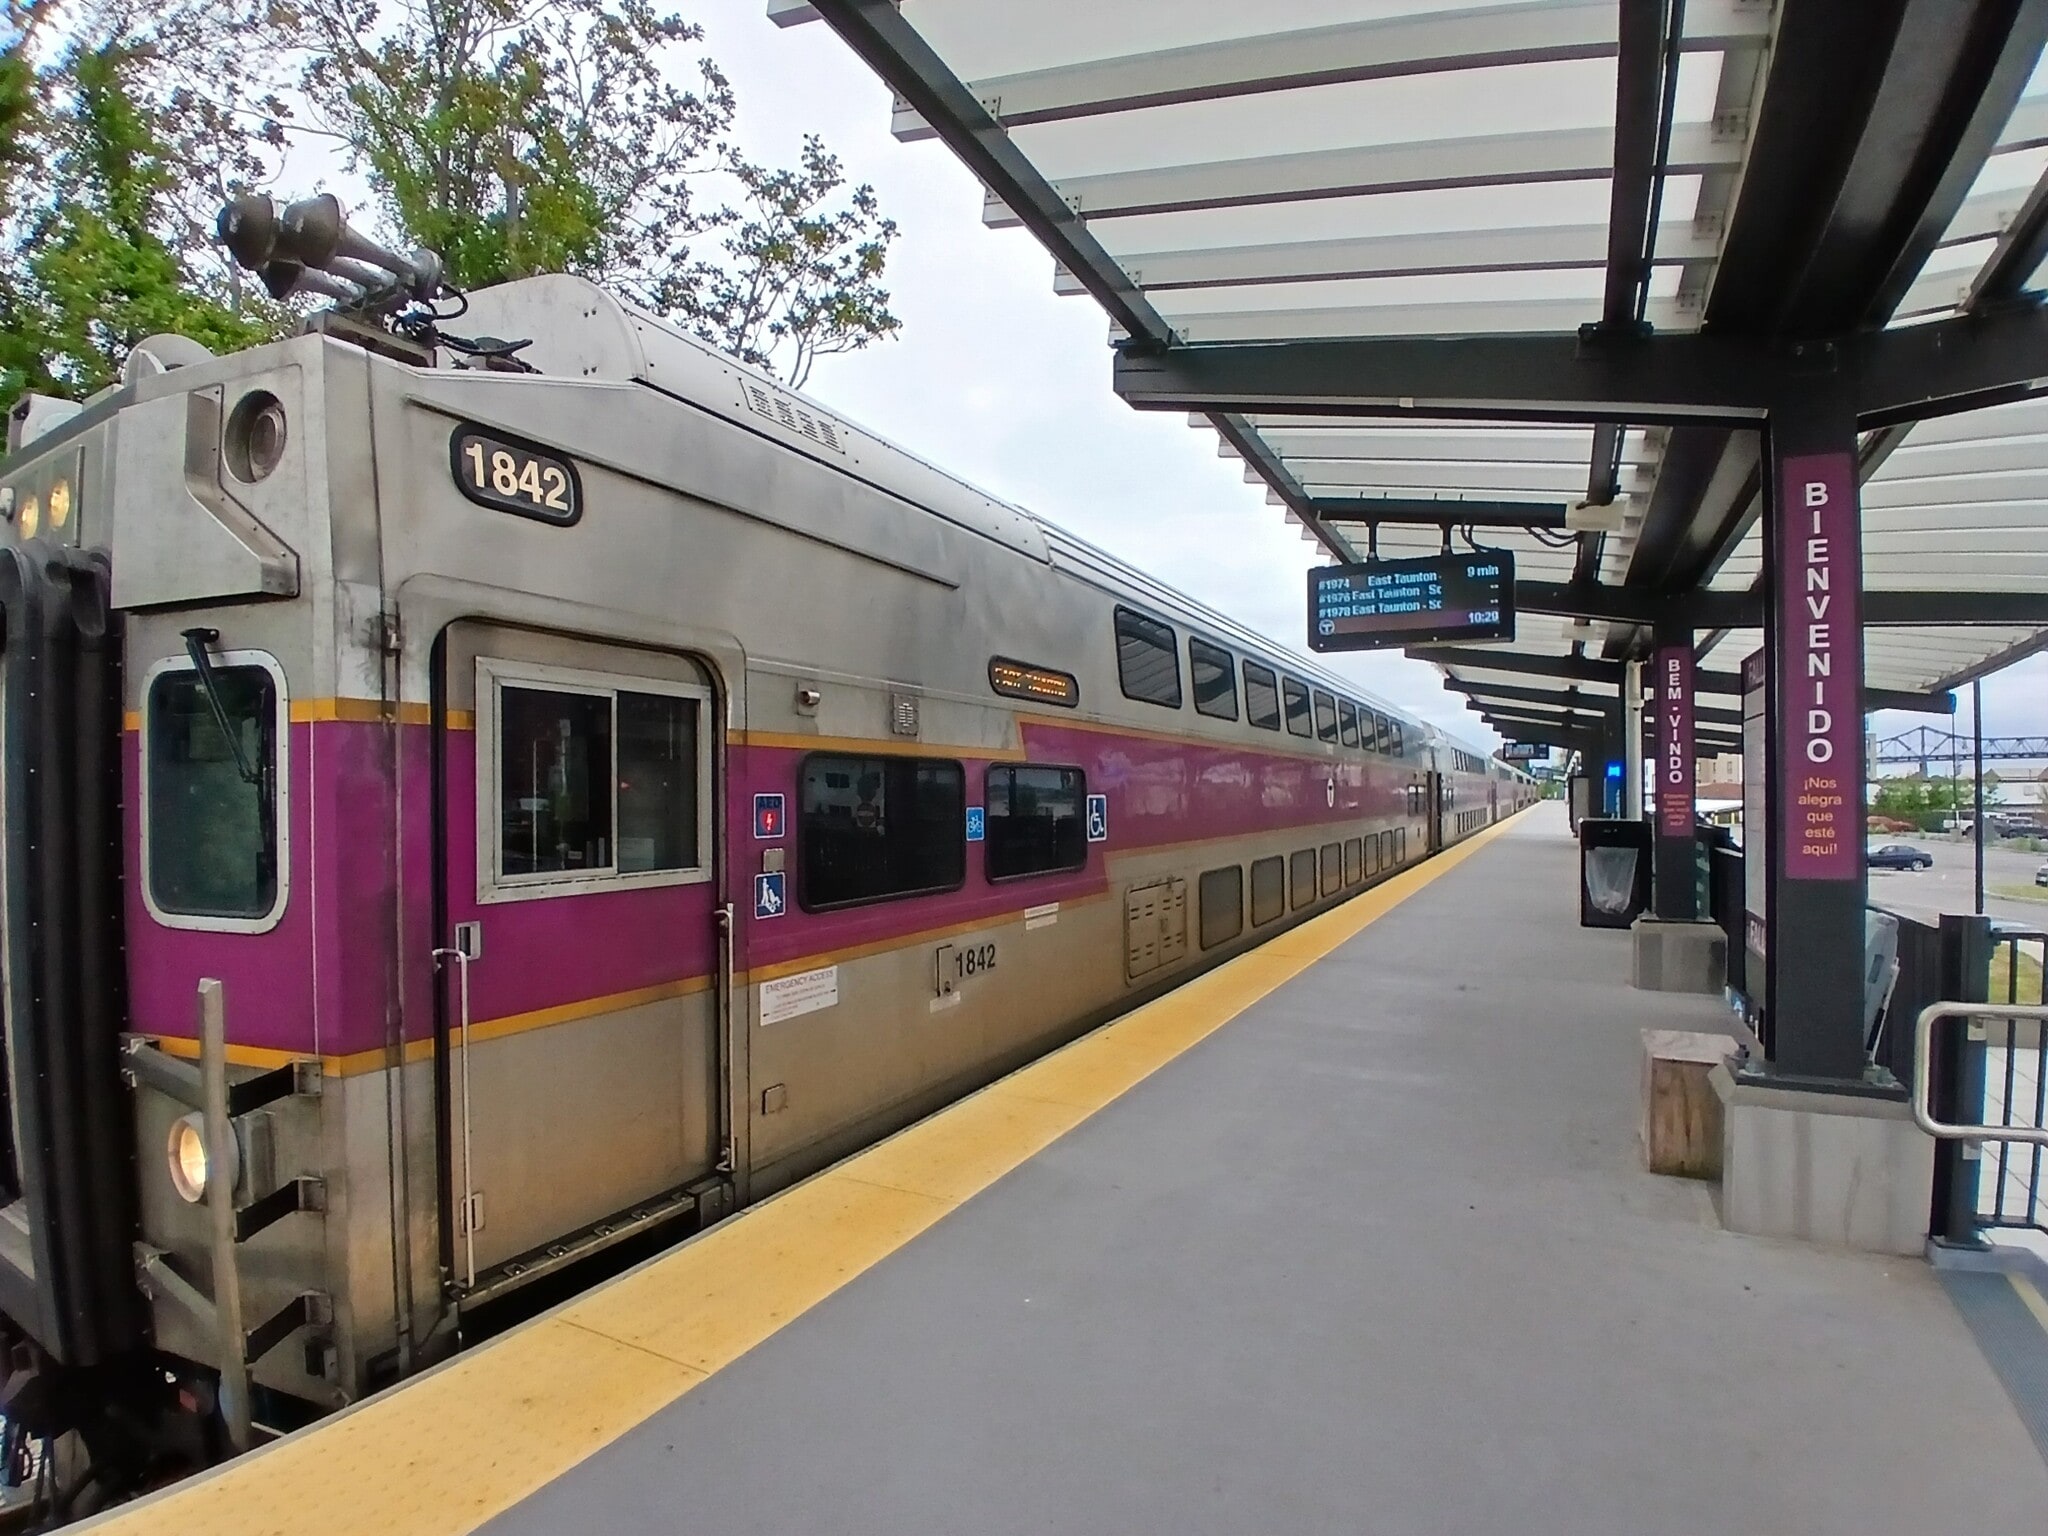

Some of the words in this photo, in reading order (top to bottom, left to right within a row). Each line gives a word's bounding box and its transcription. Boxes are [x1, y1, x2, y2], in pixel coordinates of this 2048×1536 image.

[465, 443, 568, 511] 1842
[1367, 575, 1392, 587] East
[1394, 572, 1437, 584] Taunton
[1477, 565, 1499, 576] min
[1352, 604, 1376, 615] East
[1379, 601, 1420, 613] Taunton
[1805, 482, 1833, 763] BIENVENIDO
[1804, 777, 1837, 790] ¡Nos
[1798, 795, 1842, 808] alegra
[1807, 812, 1833, 824] que
[1805, 826, 1835, 838] esté
[1803, 843, 1837, 856] aquí!
[956, 944, 996, 977] 1842
